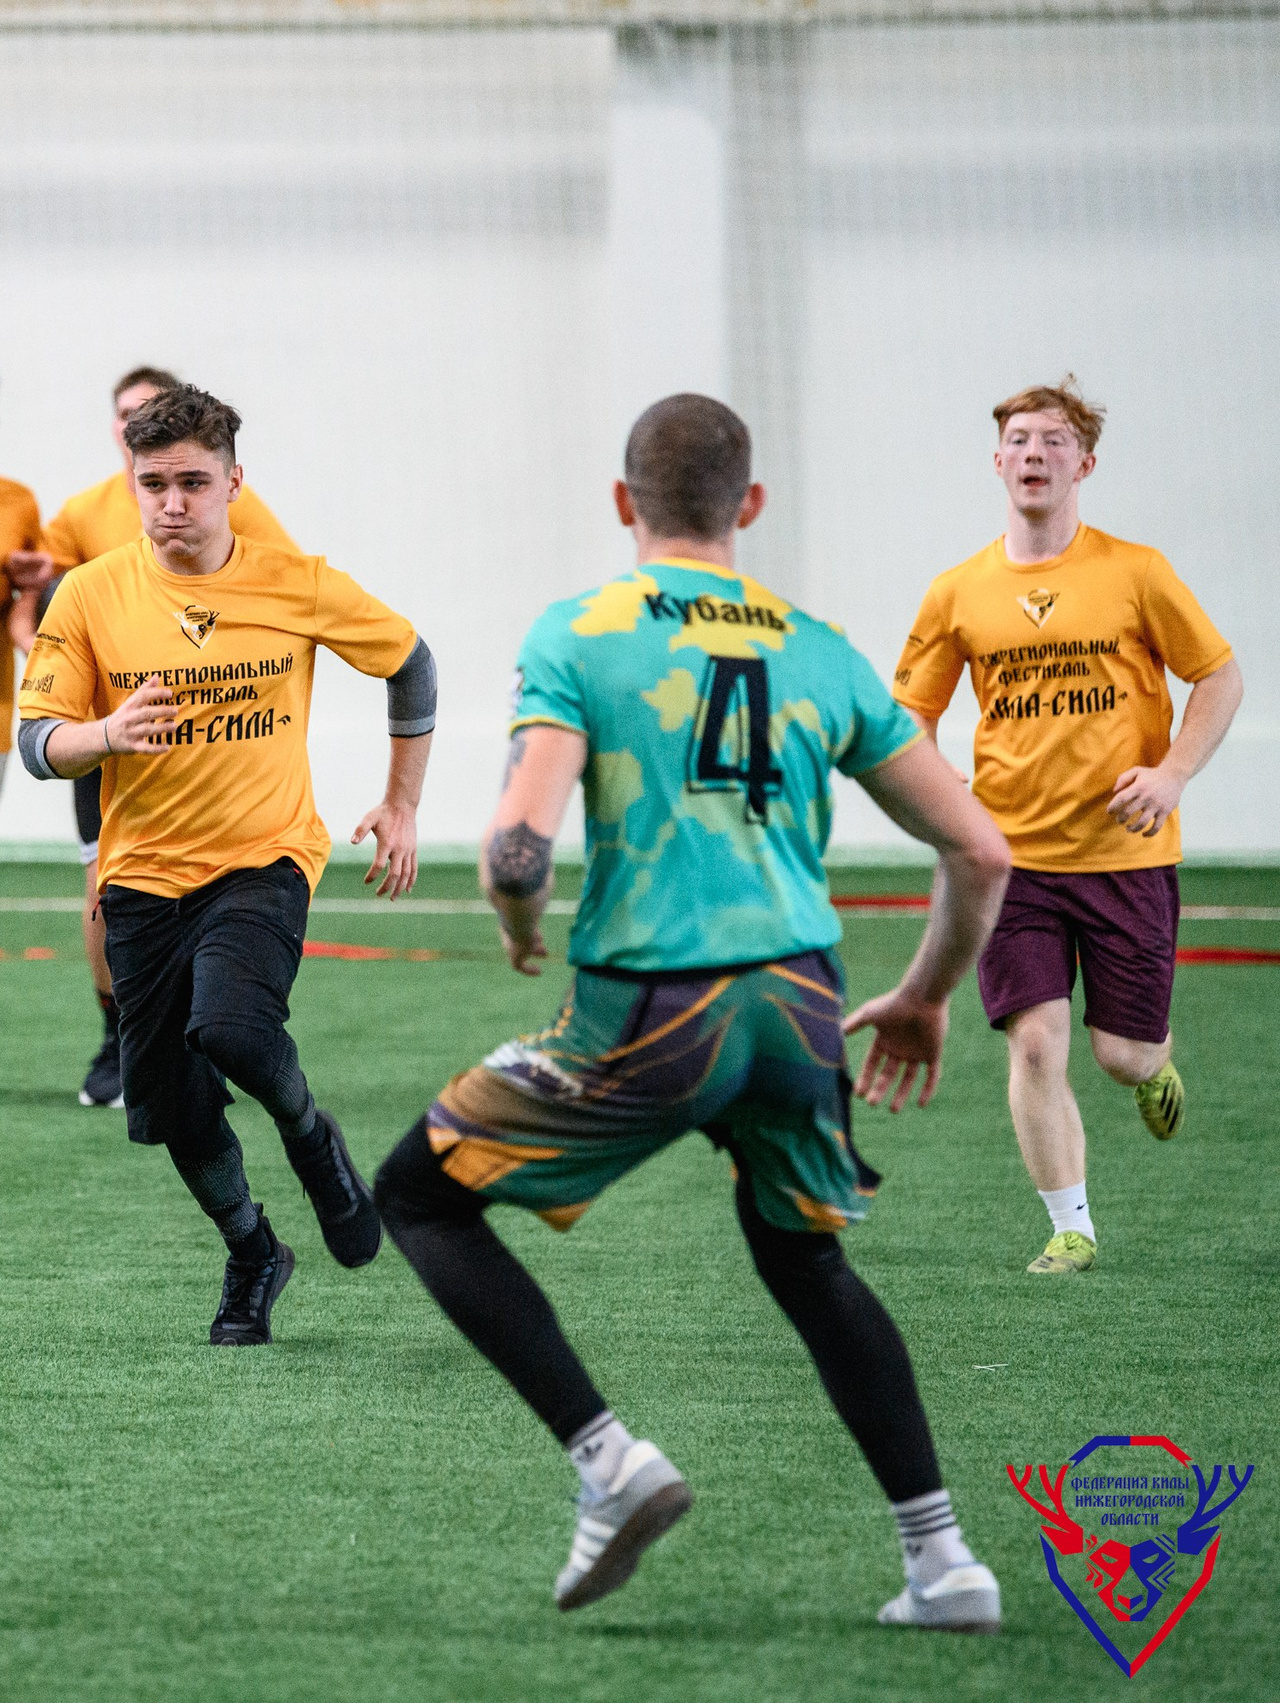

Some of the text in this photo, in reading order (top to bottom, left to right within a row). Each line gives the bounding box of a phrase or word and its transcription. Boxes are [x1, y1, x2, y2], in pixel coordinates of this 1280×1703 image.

[642, 591, 787, 632] Кубань
[998, 661, 1090, 688] ФЕСТИВАЛЬ
[686, 655, 784, 825] 4
